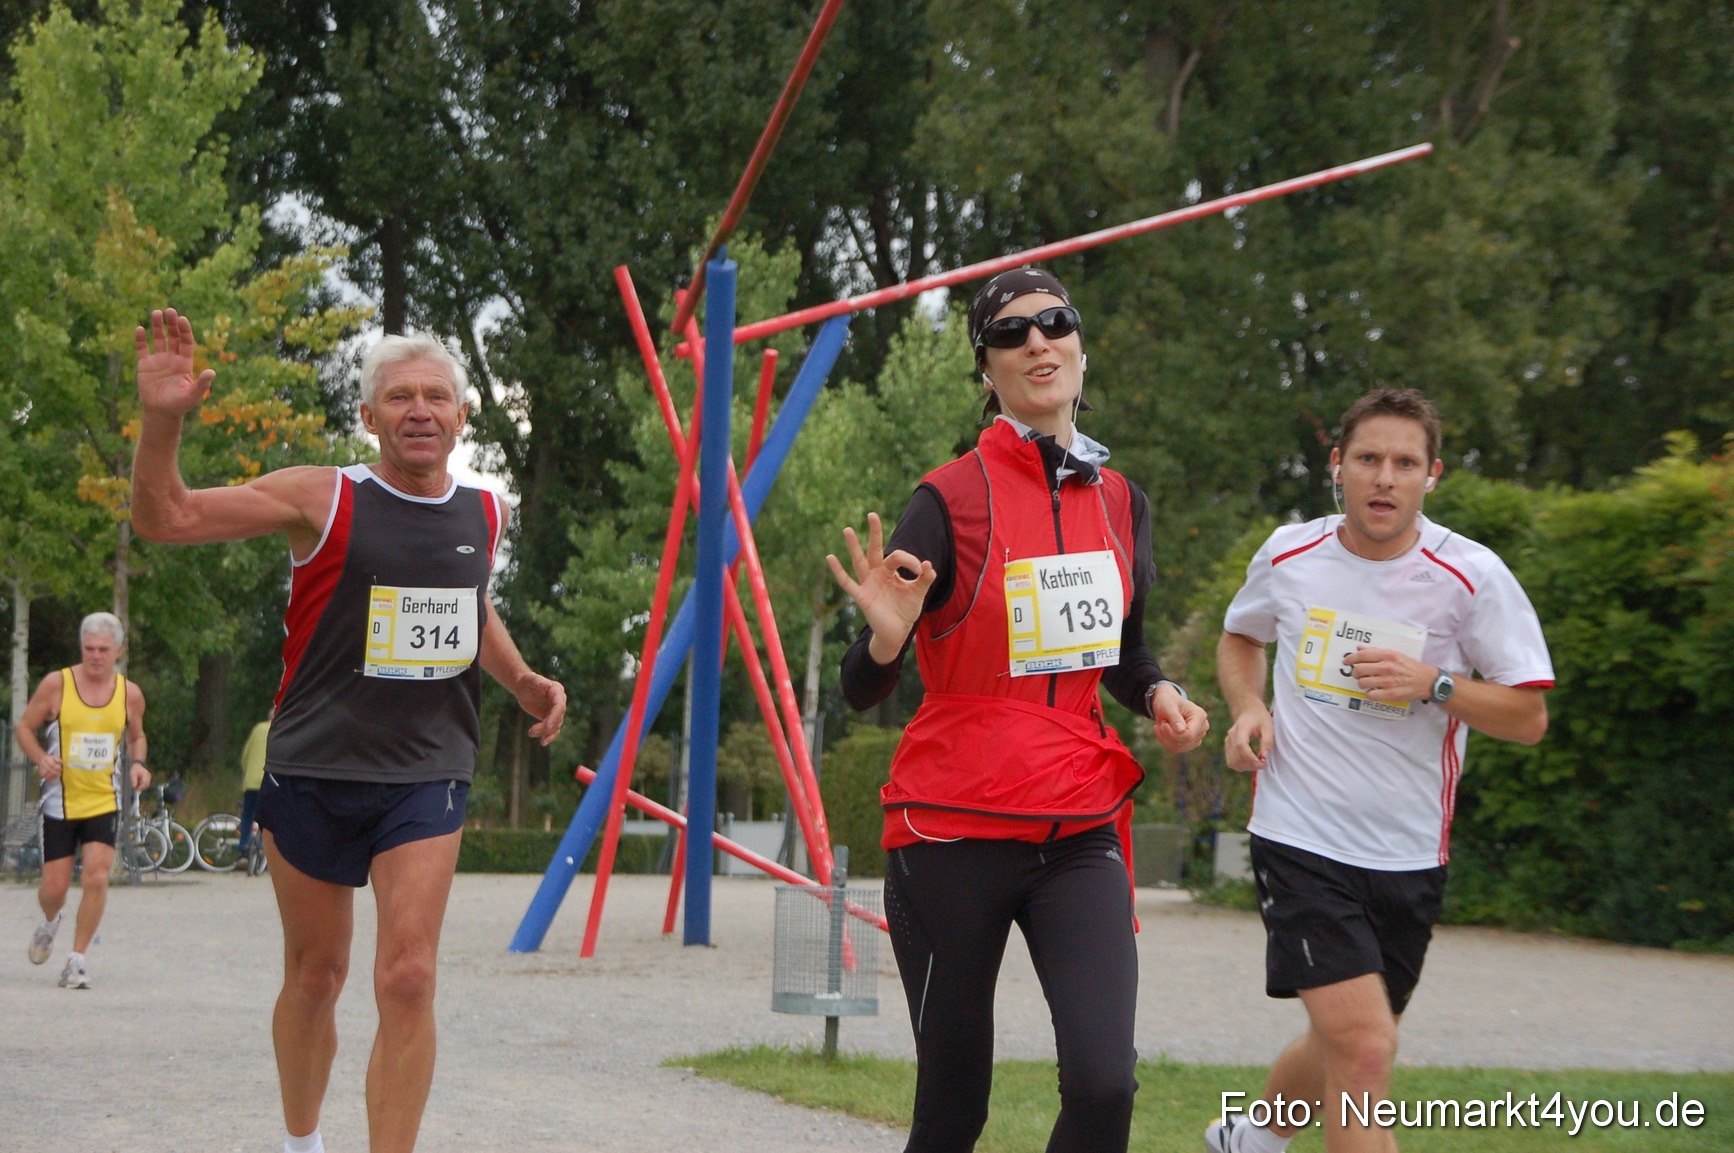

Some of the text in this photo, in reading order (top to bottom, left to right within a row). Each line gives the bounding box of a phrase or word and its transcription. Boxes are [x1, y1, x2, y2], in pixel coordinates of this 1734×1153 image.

[1040, 566, 1093, 590] Kathrin
[402, 596, 458, 614] Gerhard
[1014, 607, 1022, 623] D
[1060, 598, 1113, 633] 133
[373, 621, 381, 634] D
[1336, 621, 1372, 644] Jens
[410, 625, 460, 649] 314
[1305, 641, 1314, 654] D
[87, 747, 108, 758] 760
